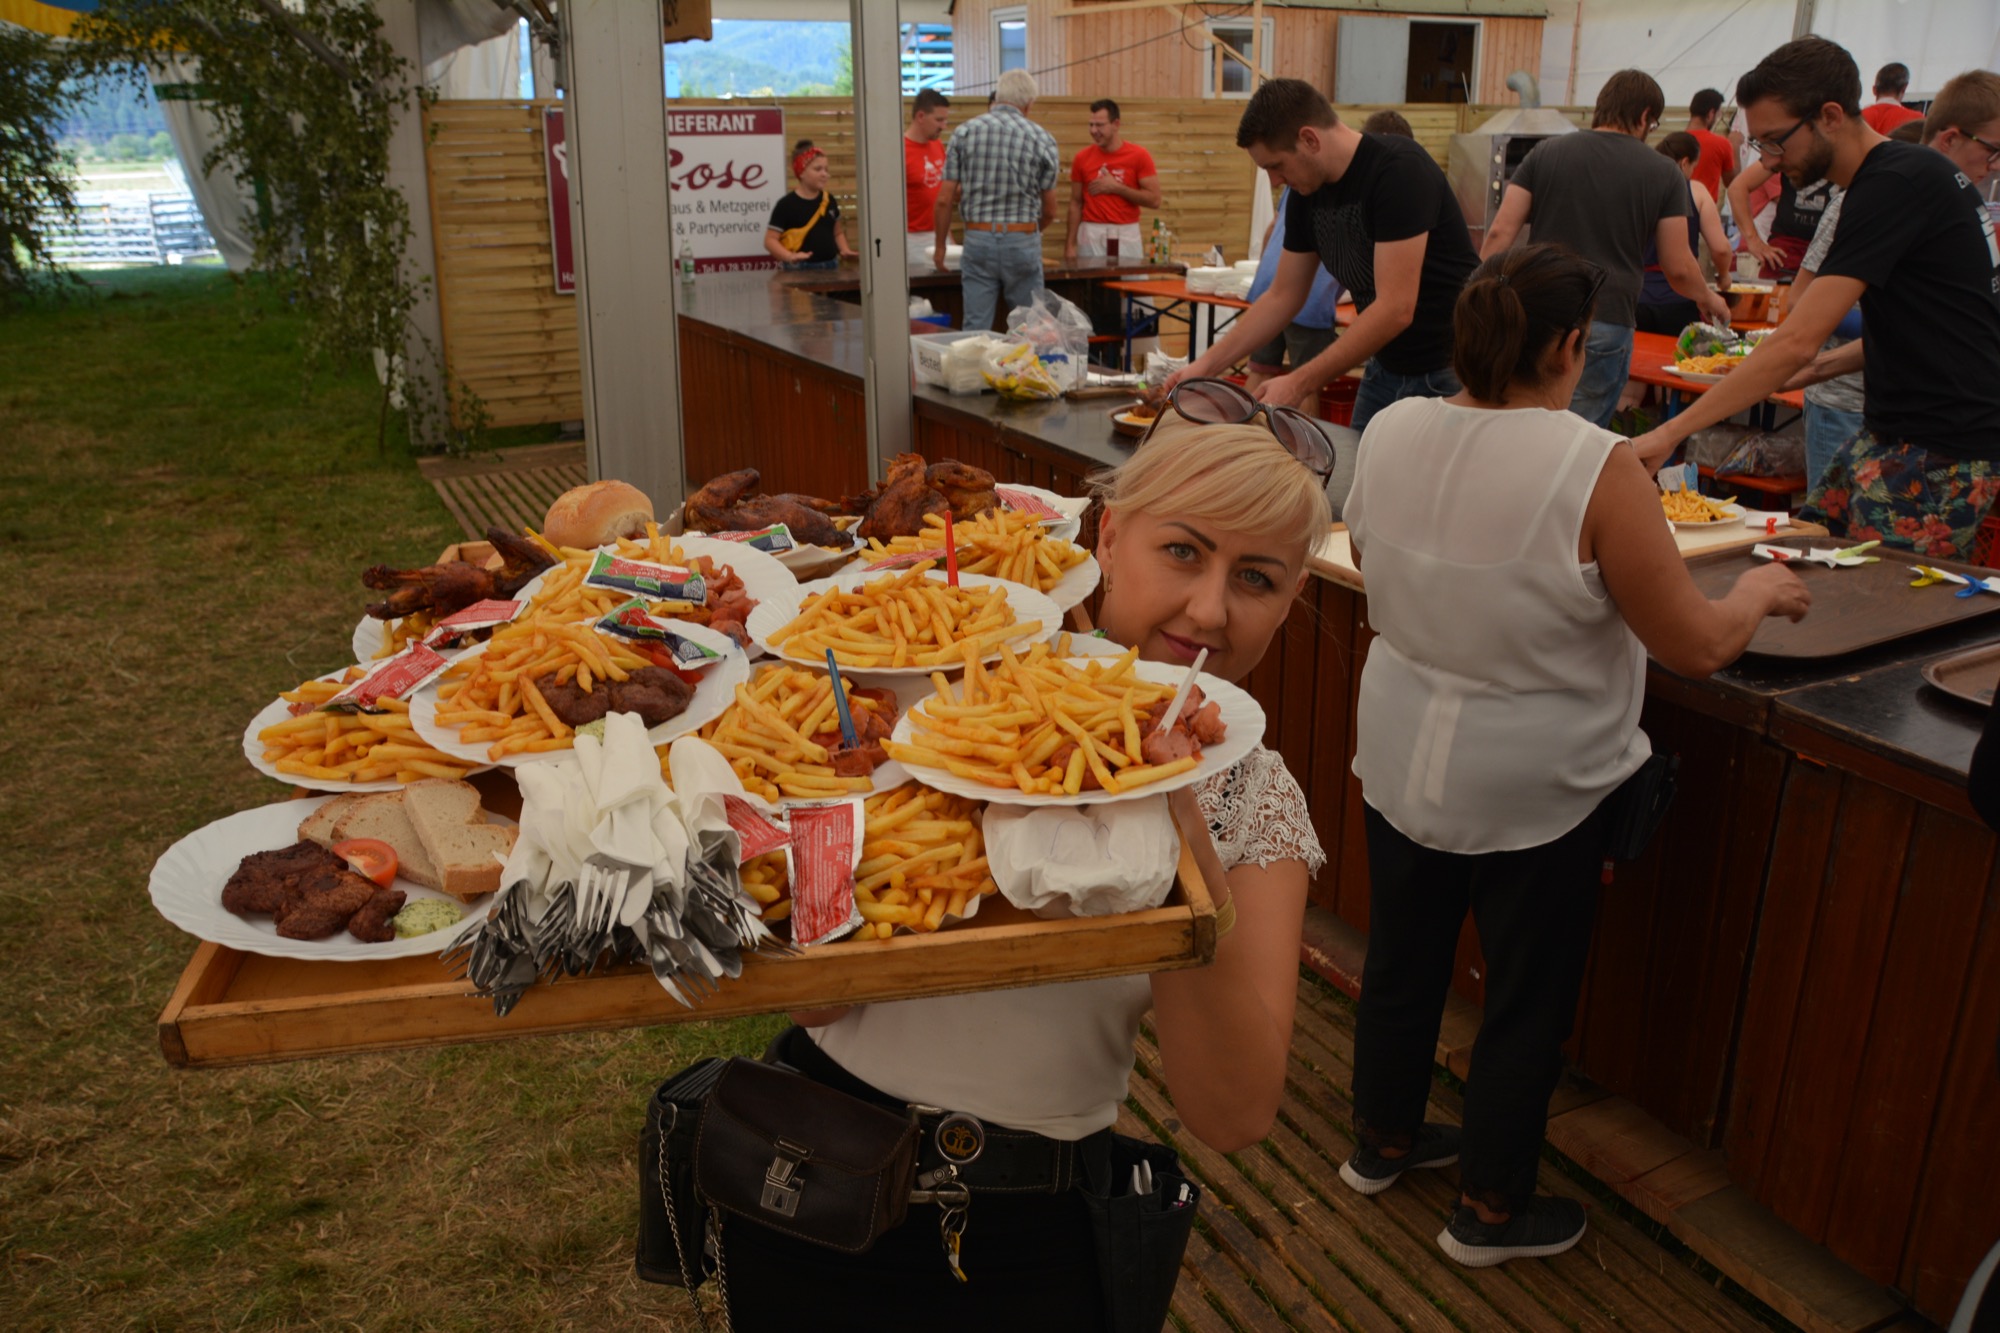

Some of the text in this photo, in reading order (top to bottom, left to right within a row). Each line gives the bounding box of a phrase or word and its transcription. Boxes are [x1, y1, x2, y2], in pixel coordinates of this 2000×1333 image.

[668, 114, 756, 132] IEFERANT
[672, 198, 771, 216] aus & Metzgerei
[689, 219, 760, 237] Partyservice
